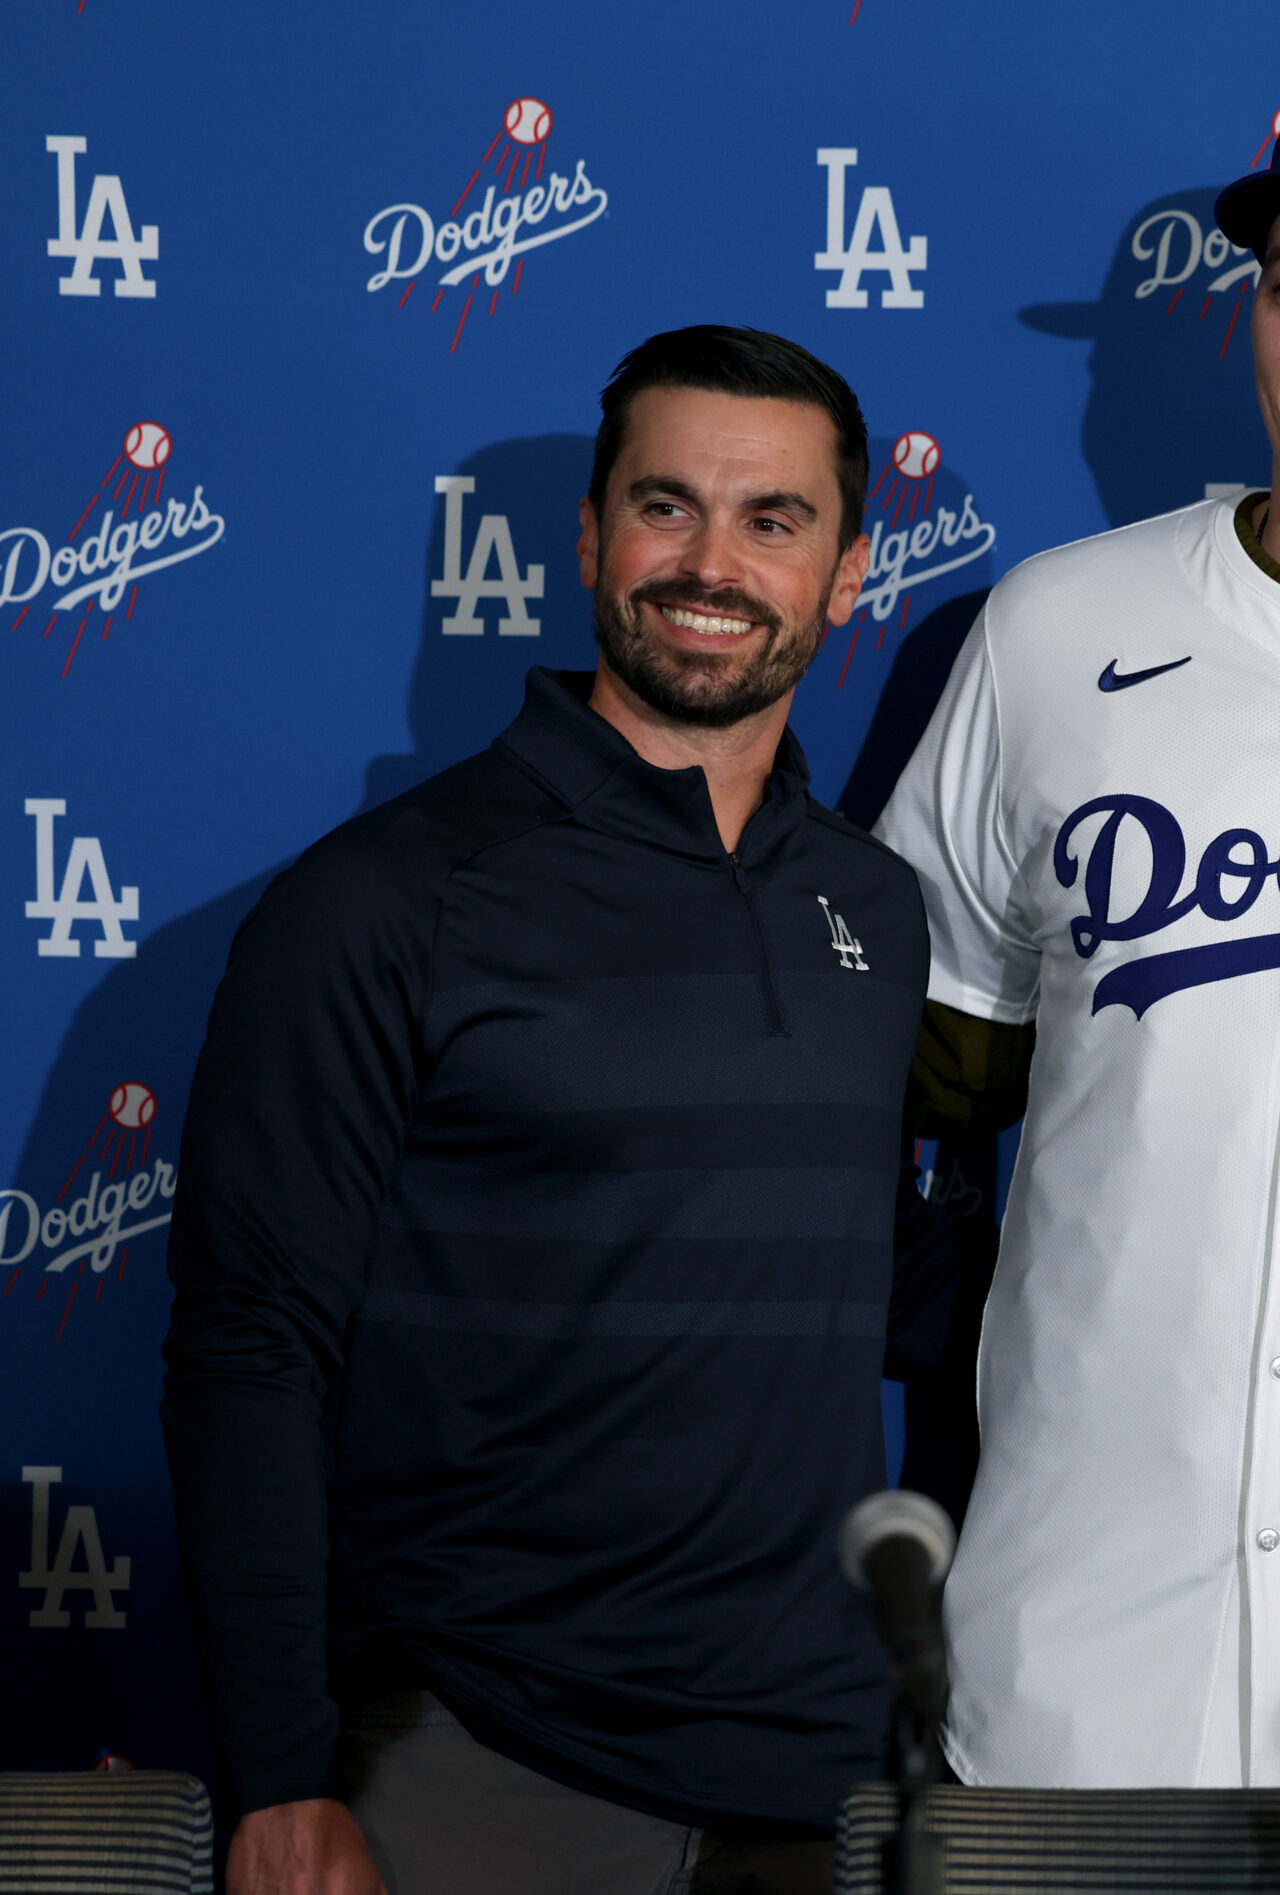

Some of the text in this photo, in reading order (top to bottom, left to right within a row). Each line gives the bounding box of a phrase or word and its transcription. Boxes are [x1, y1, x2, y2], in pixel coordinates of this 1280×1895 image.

[46, 136, 158, 297] LA
[364, 160, 607, 291] Dodgers
[815, 149, 927, 308] LA
[0, 486, 224, 611] Dodgers
[432, 476, 544, 635] LA
[25, 799, 139, 957] LA
[818, 896, 869, 970] LA
[0, 1158, 177, 1272] Dodger
[18, 1466, 131, 1628] LA
